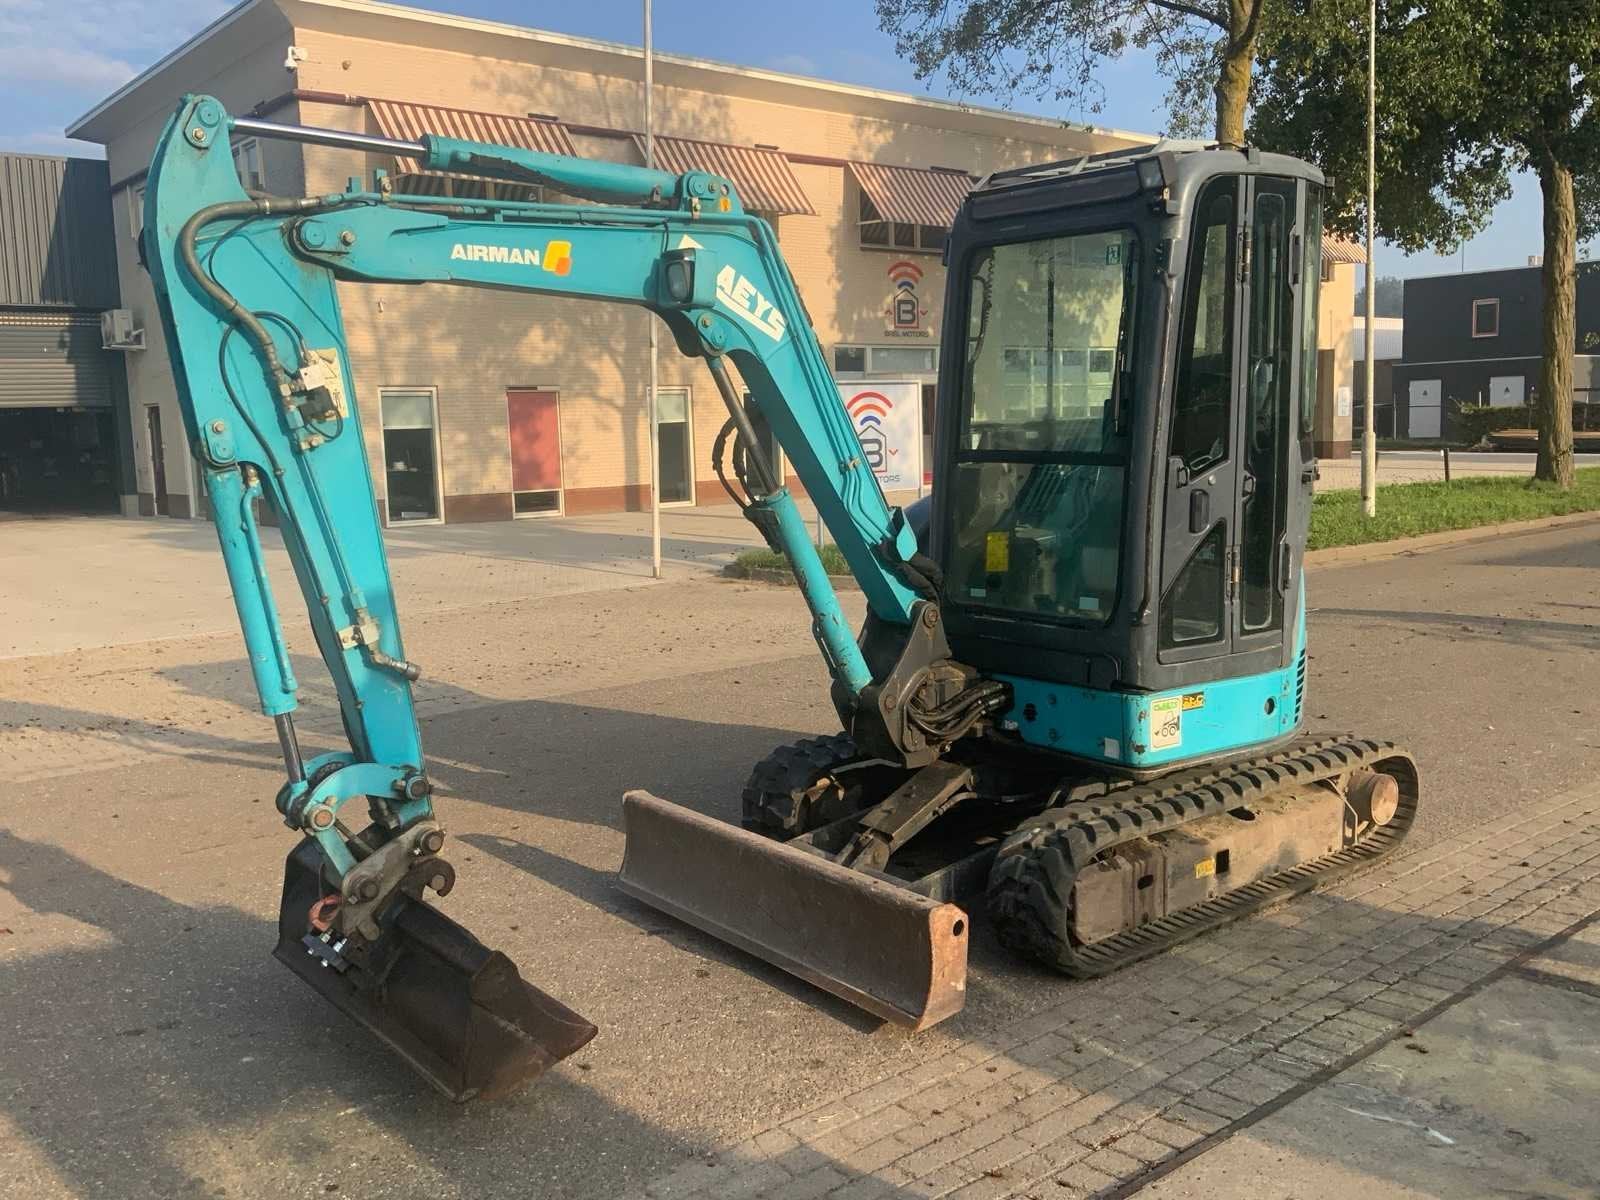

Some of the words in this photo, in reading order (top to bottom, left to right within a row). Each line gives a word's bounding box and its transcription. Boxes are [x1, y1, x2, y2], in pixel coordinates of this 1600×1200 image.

[451, 243, 540, 265] AIRMAN
[896, 299, 916, 324] B
[902, 330, 930, 338] MOTORS
[878, 474, 901, 483] TORS
